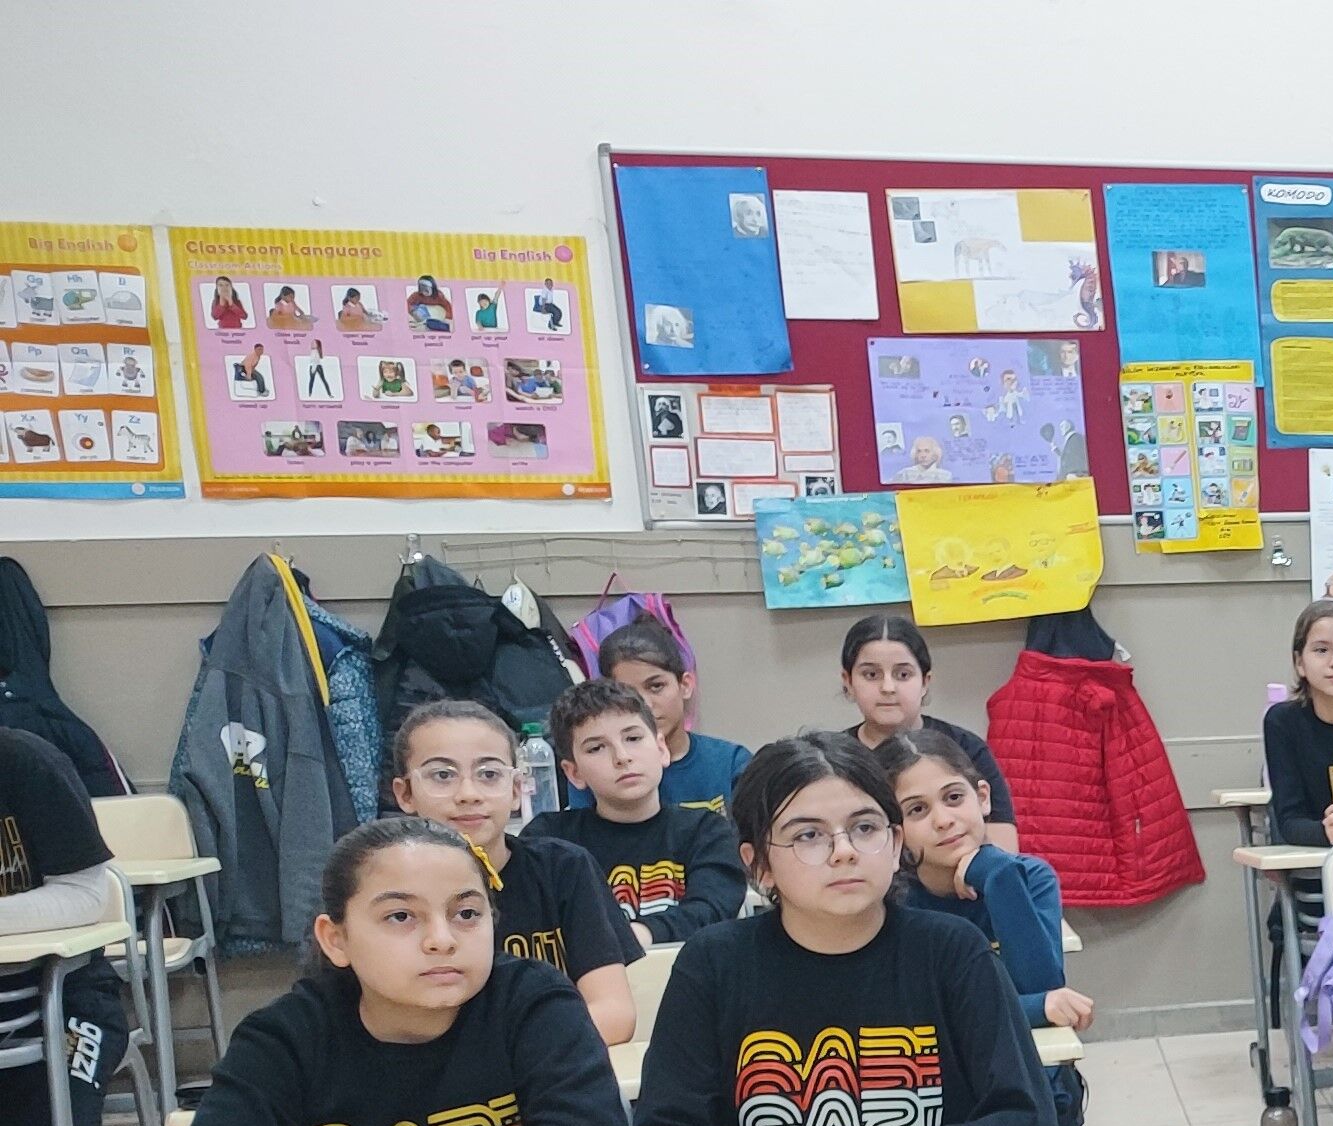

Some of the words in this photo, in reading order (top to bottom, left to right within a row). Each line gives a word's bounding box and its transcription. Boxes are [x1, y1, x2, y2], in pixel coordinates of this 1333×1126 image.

[29, 237, 53, 251] Big
[58, 238, 114, 252] English
[186, 240, 284, 256] Classroom
[290, 242, 382, 259] Language
[473, 248, 496, 262] Big
[500, 249, 552, 263] English
